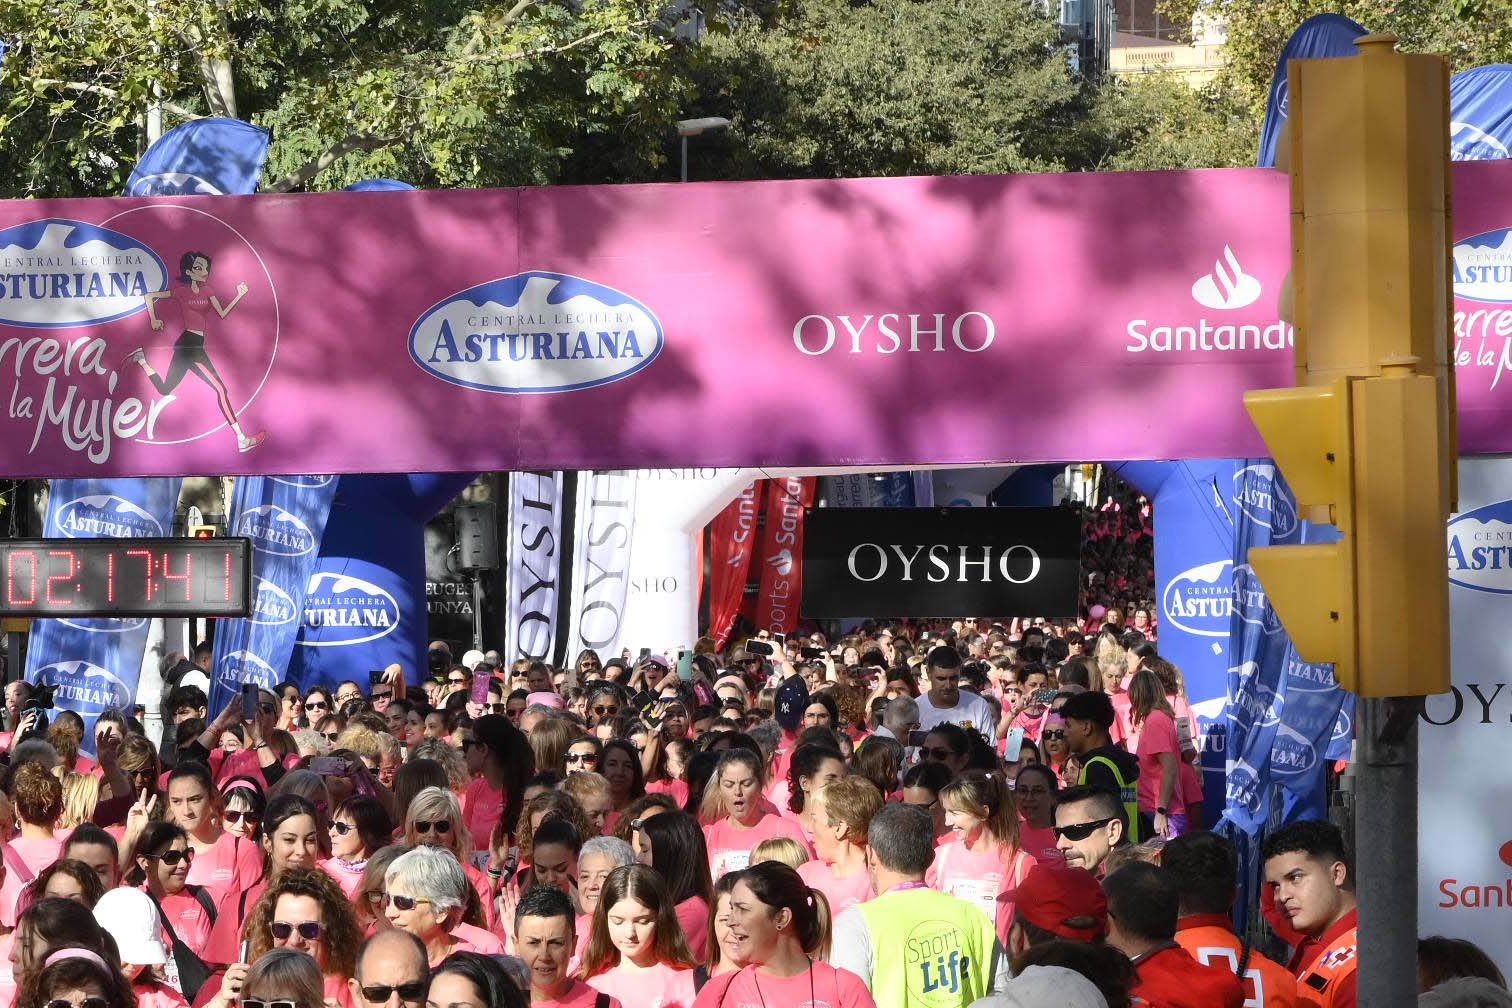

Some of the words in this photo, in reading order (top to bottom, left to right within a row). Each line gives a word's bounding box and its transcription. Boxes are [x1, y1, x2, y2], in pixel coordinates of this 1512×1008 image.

[70, 254, 144, 266] LECHERA
[467, 314, 546, 327] CENTRAL
[553, 312, 635, 325] LECHERA
[792, 311, 995, 356] OYSHO
[427, 318, 644, 363] ASTURIANA
[1476, 336, 1495, 366] la
[8, 379, 34, 419] la
[28, 369, 177, 464] Mujer
[7, 551, 231, 605] 02:17:41
[847, 543, 1041, 585] OYSHO
[337, 597, 386, 606] LECHERA
[1187, 587, 1231, 595] CENTRA
[1418, 682, 1512, 727] OY
[907, 927, 961, 964] Sport
[920, 950, 970, 994] Life
